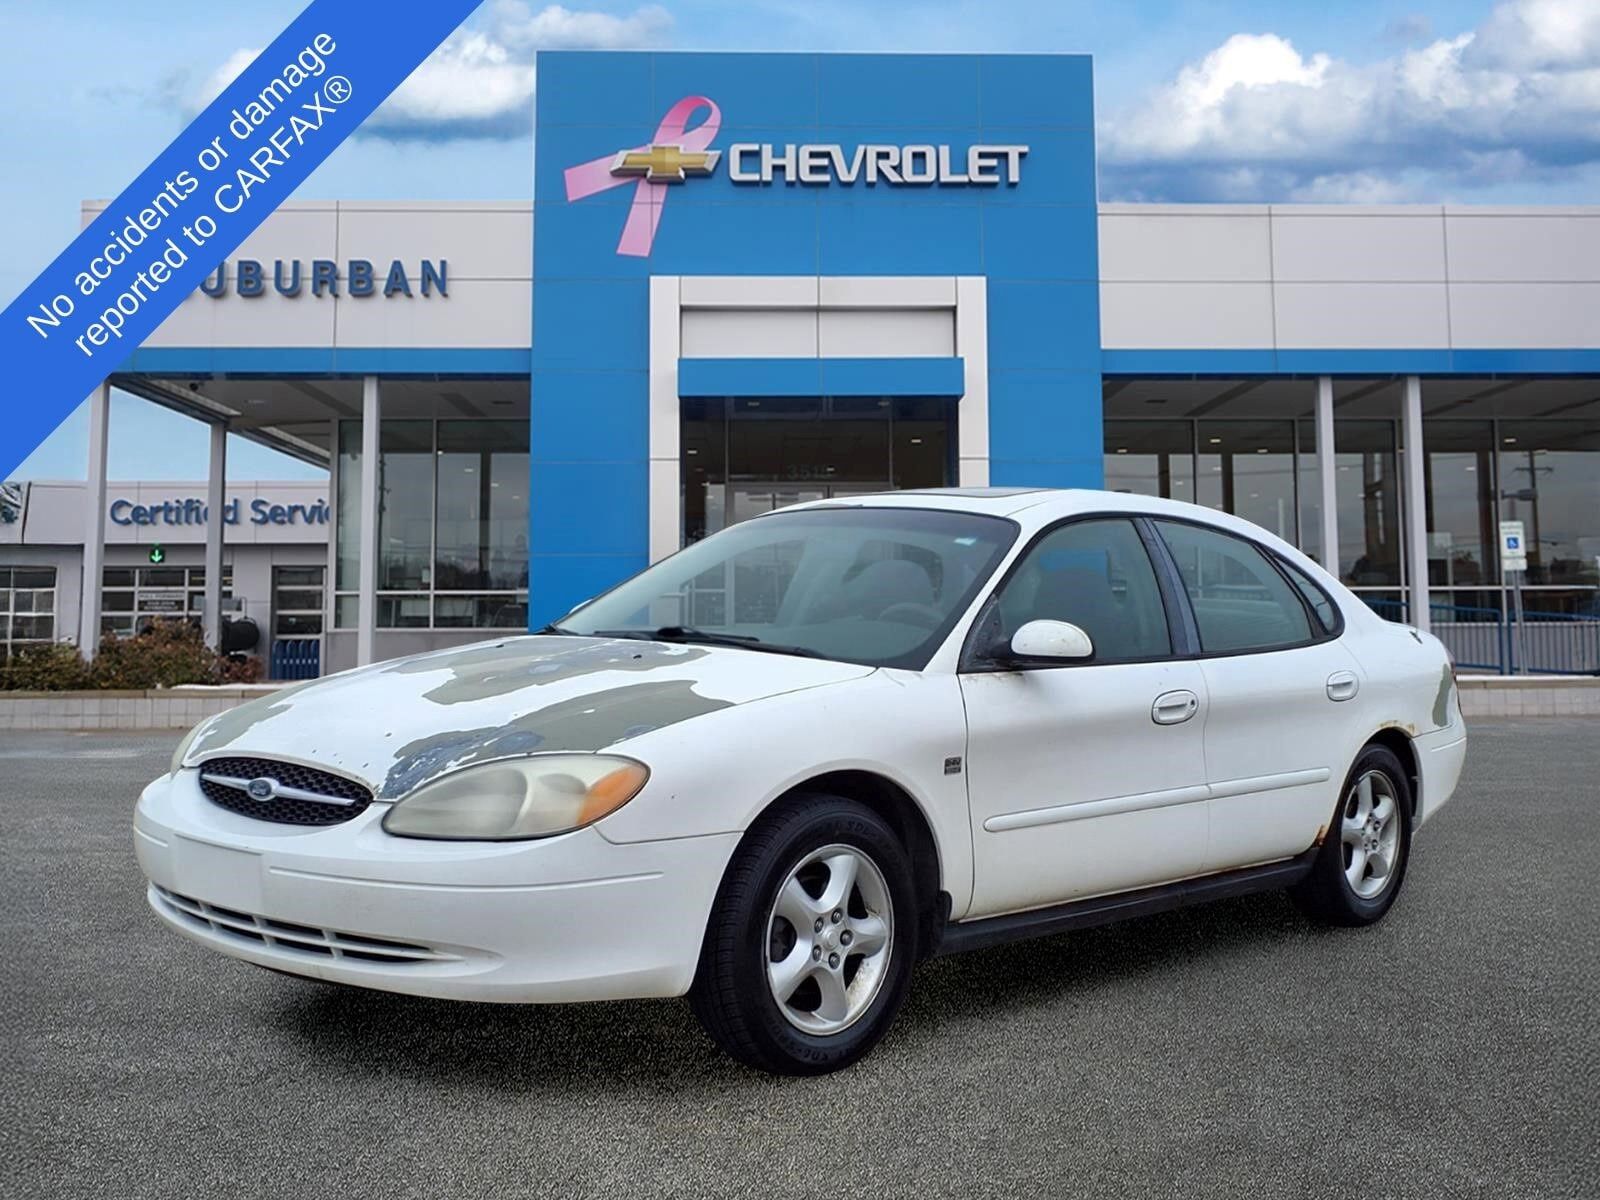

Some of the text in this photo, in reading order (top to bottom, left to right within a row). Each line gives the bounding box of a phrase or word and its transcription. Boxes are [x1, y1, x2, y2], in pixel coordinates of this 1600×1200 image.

[728, 143, 1030, 185] CHEVROLET
[200, 260, 449, 298] UBURBAN
[110, 498, 330, 526] Certifid Servi
